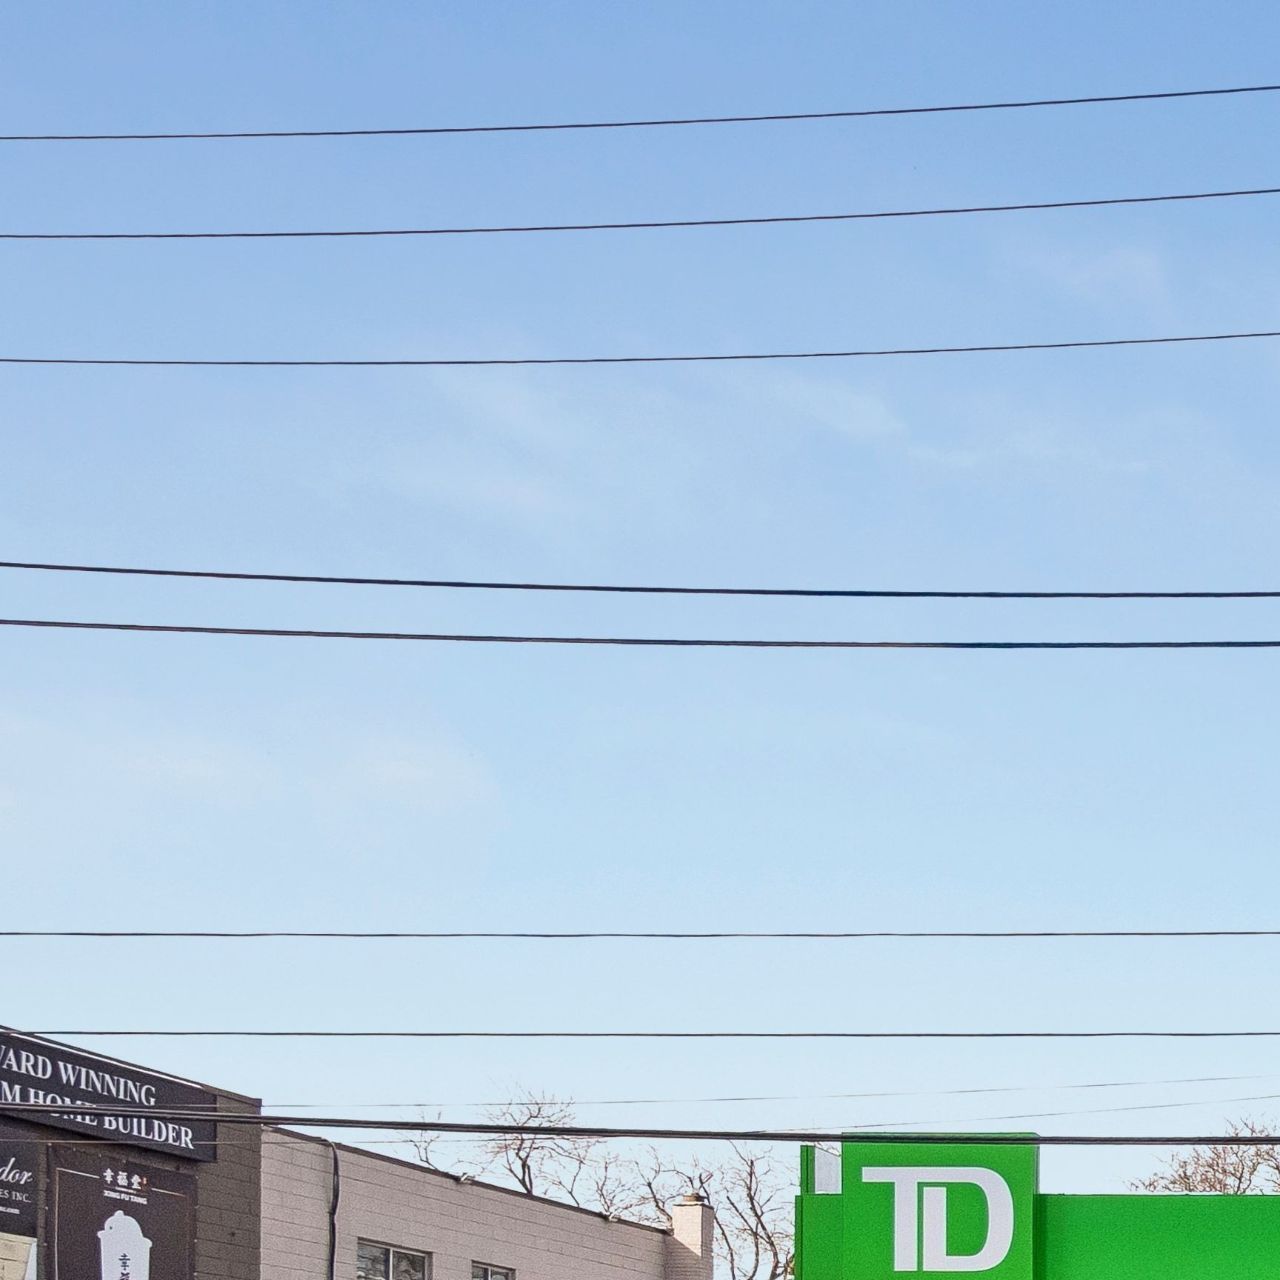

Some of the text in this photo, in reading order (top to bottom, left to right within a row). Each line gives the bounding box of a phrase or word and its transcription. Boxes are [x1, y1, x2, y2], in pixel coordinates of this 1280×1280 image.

[0, 1044, 157, 1107] ARD WINNING
[103, 1108, 195, 1150] BUILDER
[862, 1166, 1015, 1272] TD
